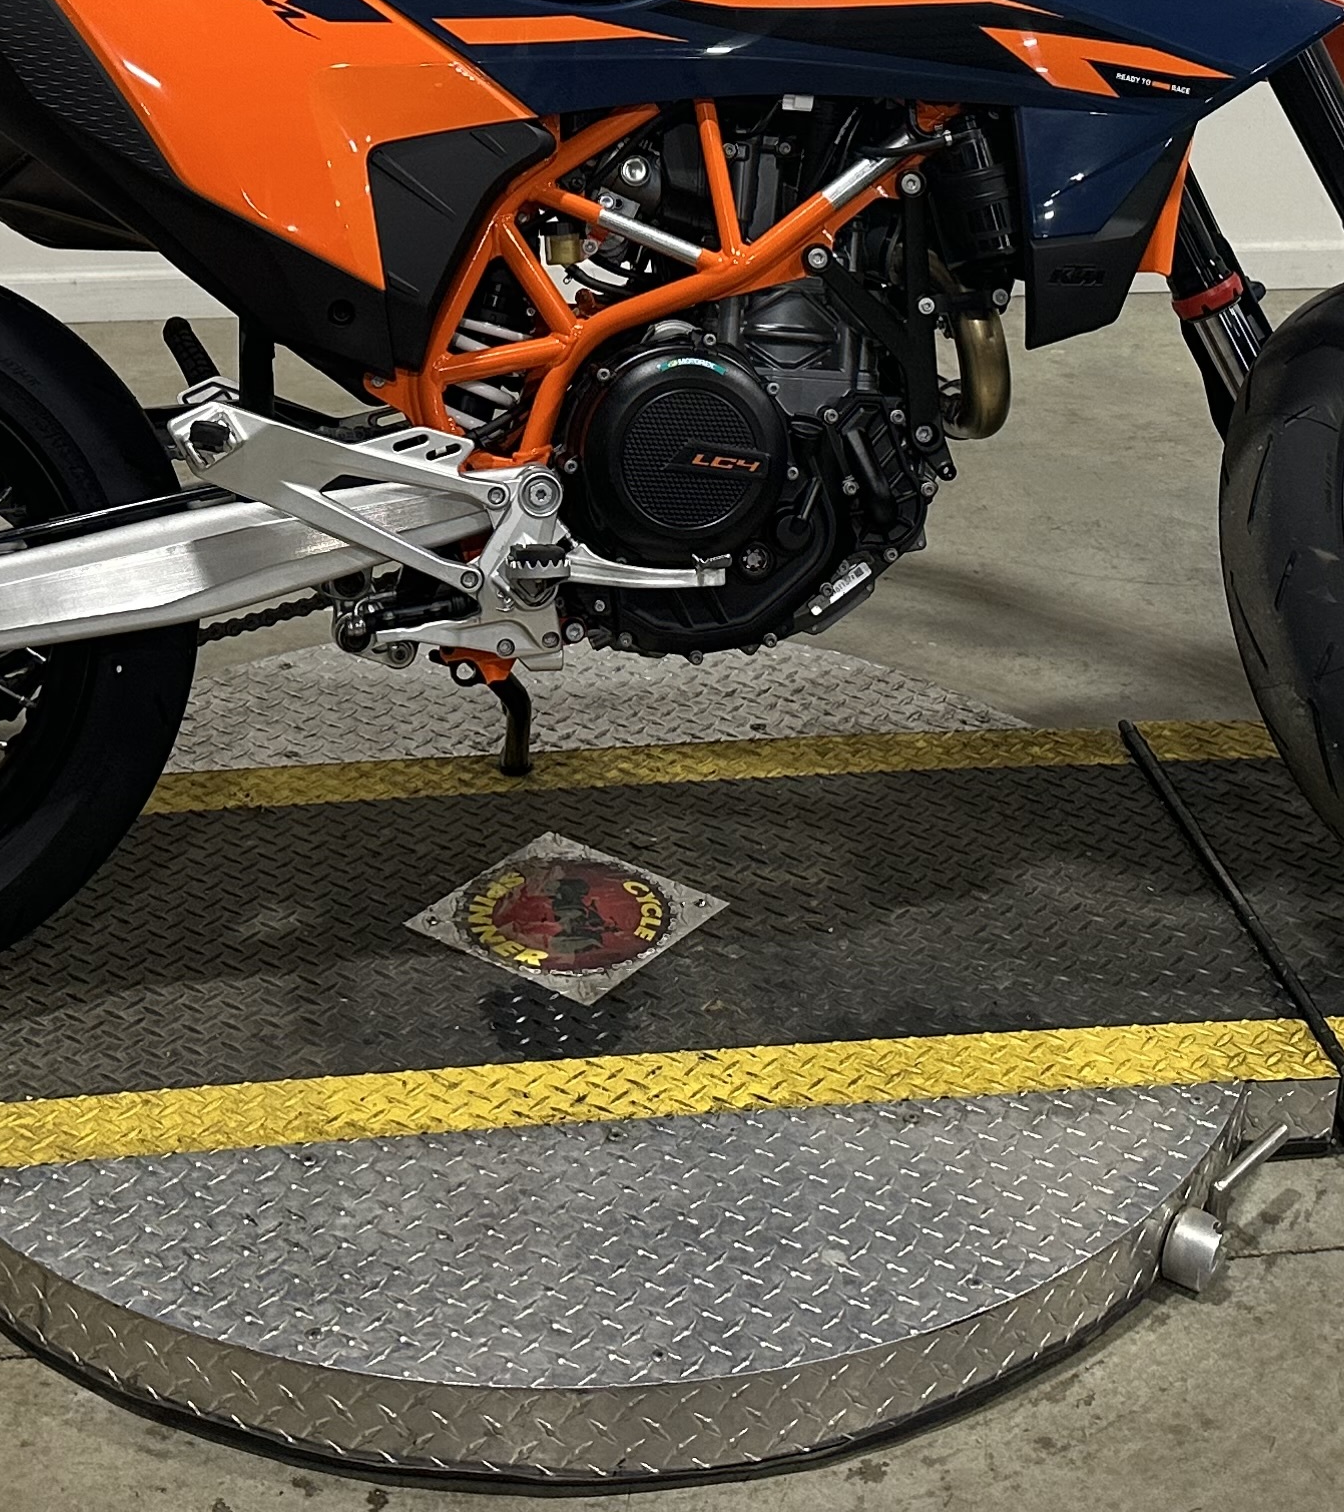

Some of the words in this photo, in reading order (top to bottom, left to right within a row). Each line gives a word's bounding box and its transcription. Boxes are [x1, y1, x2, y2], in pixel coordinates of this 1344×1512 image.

[1116, 73, 1141, 84] READY
[1141, 78, 1152, 86] TO
[1171, 84, 1191, 95] RACE
[1047, 264, 1105, 287] KTM
[691, 453, 760, 473] LC4
[468, 872, 549, 966] SPINNER
[622, 881, 663, 942] CYCLE
